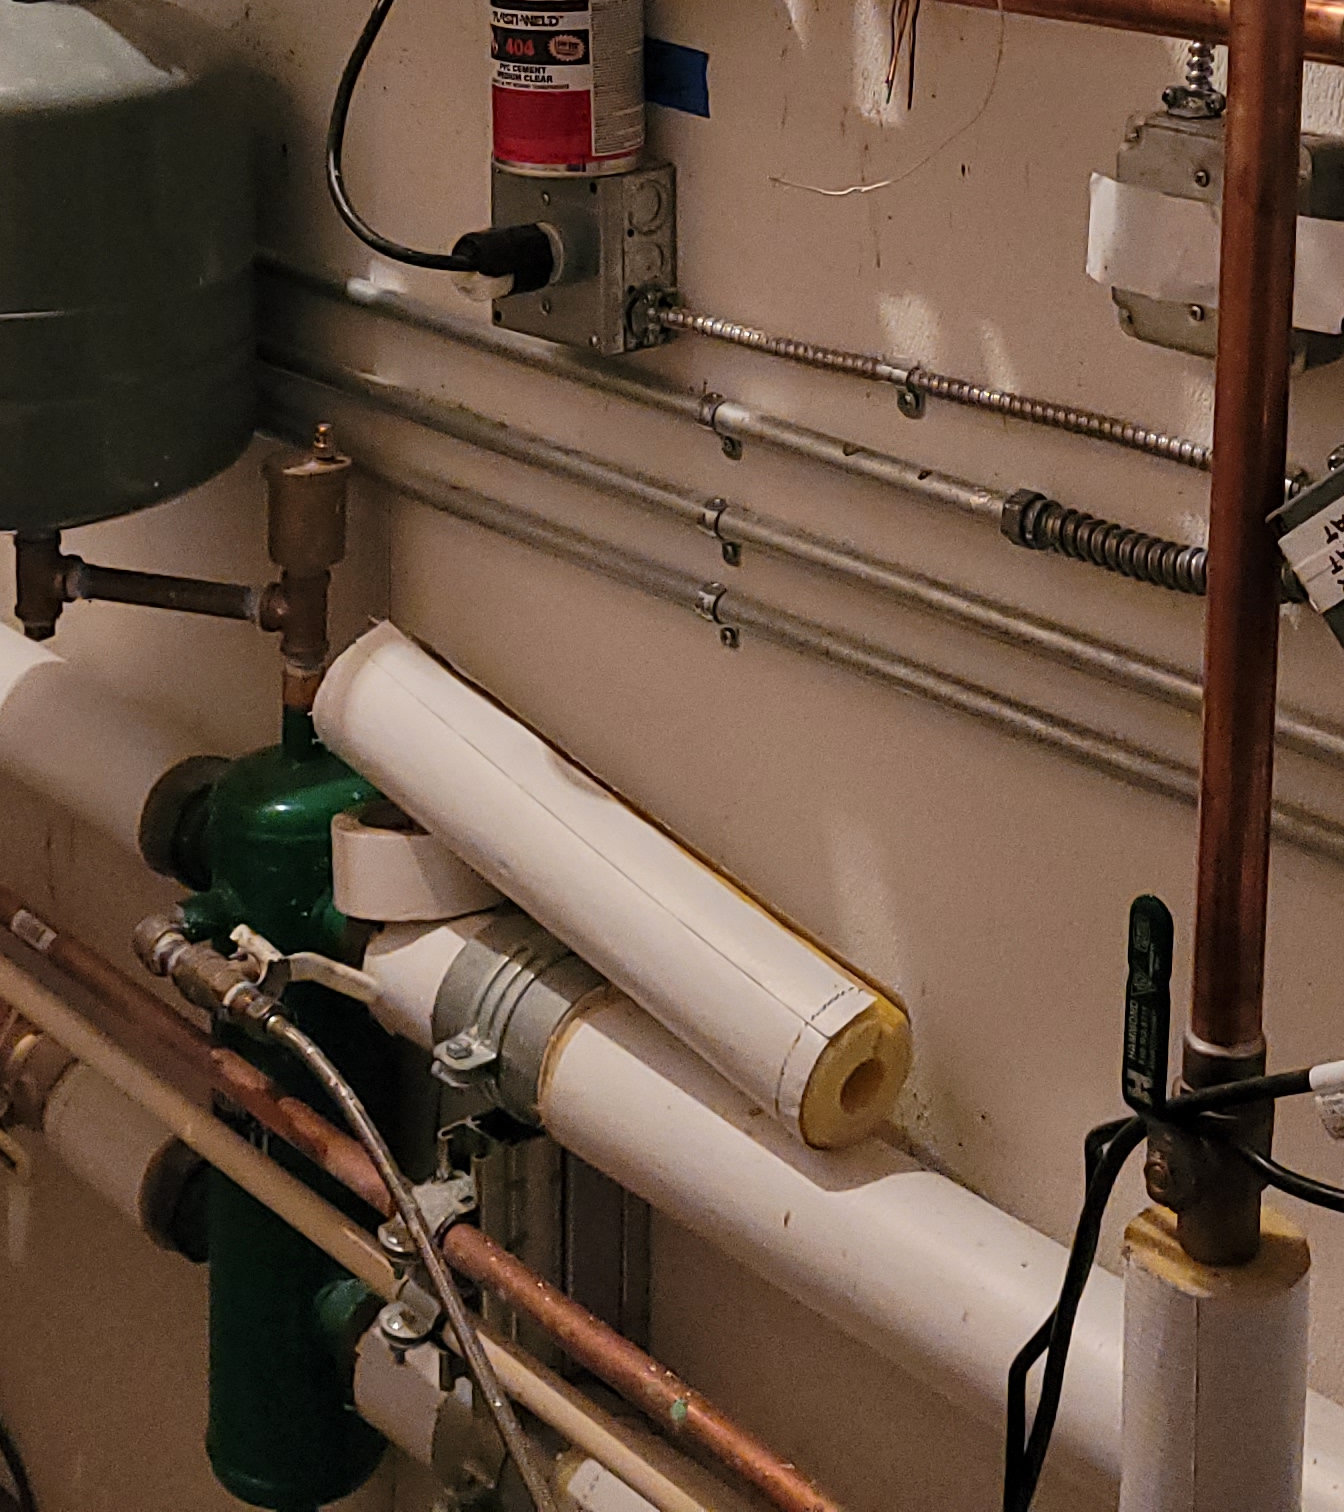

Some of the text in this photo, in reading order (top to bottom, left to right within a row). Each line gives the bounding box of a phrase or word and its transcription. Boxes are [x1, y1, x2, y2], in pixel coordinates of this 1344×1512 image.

[505, 38, 536, 57] 404
[512, 64, 547, 75] CEMENT
[523, 74, 554, 84] CLEAR
